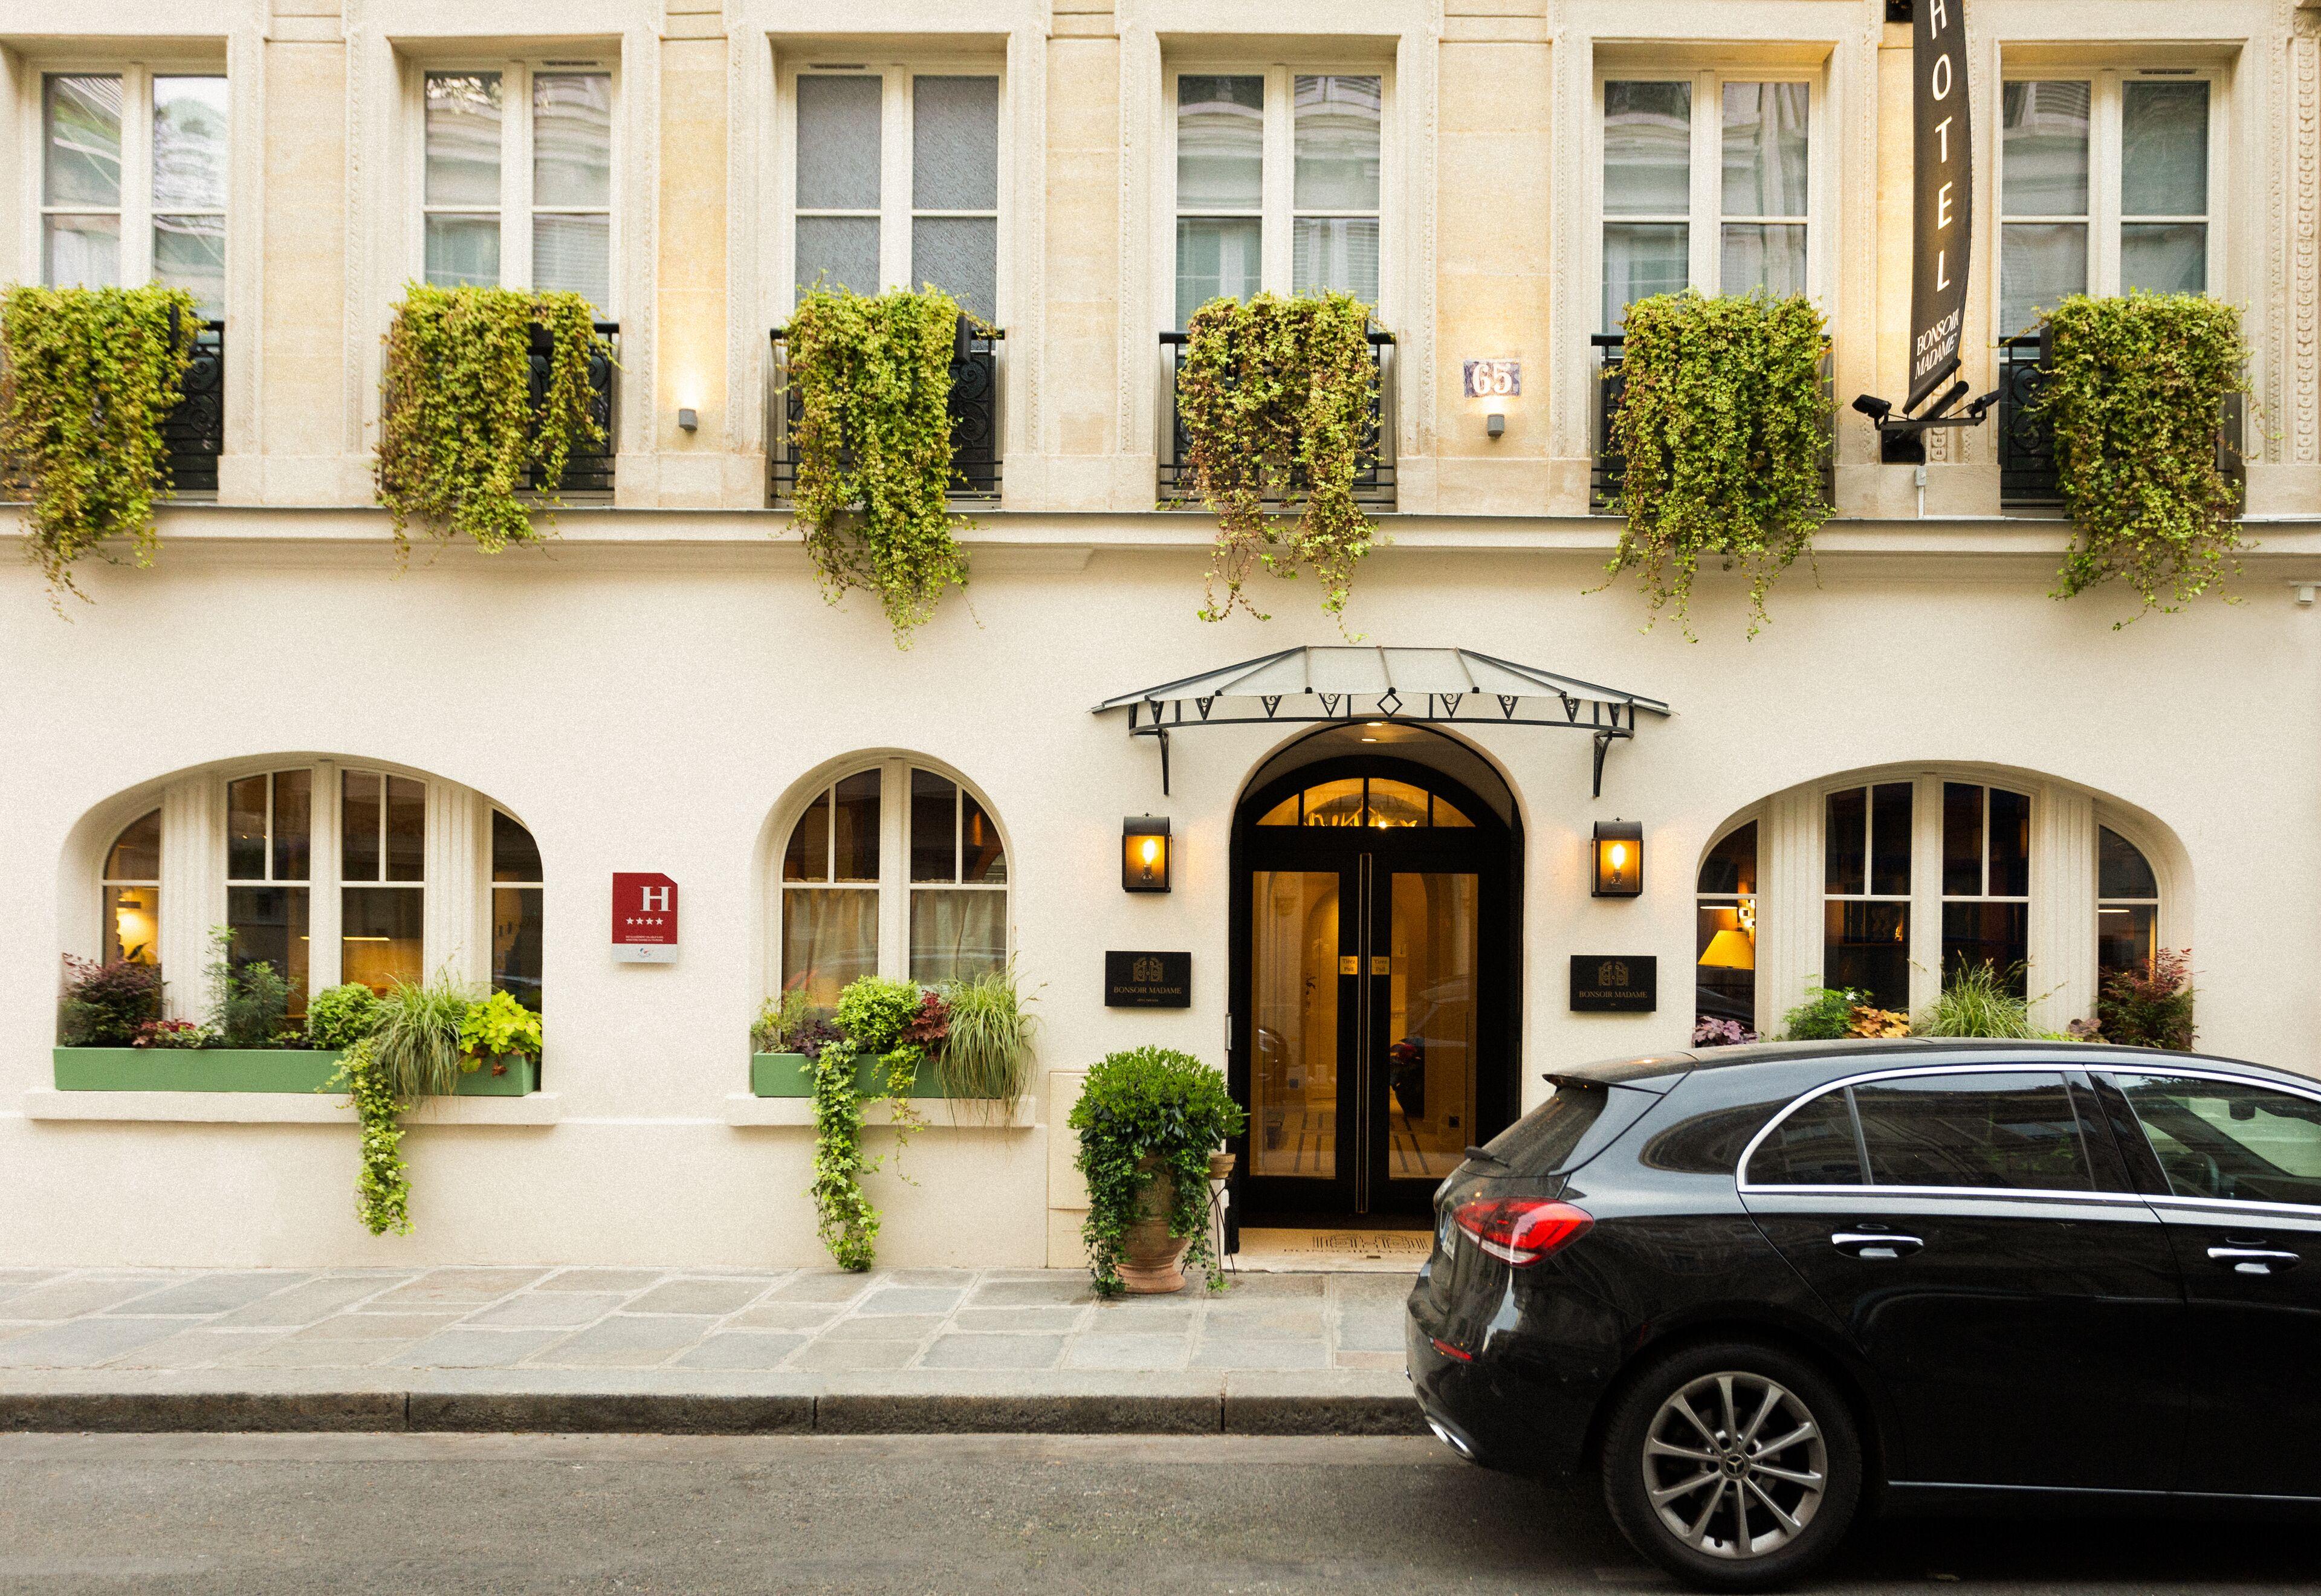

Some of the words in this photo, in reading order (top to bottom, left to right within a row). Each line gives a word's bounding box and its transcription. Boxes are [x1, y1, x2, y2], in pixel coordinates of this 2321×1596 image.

[1929, 0, 1954, 292] HOTEL
[1915, 332, 1957, 380] MADAME
[1916, 308, 1959, 357] BONSOIR
[1472, 363, 1512, 394] 65
[639, 886, 672, 911] H
